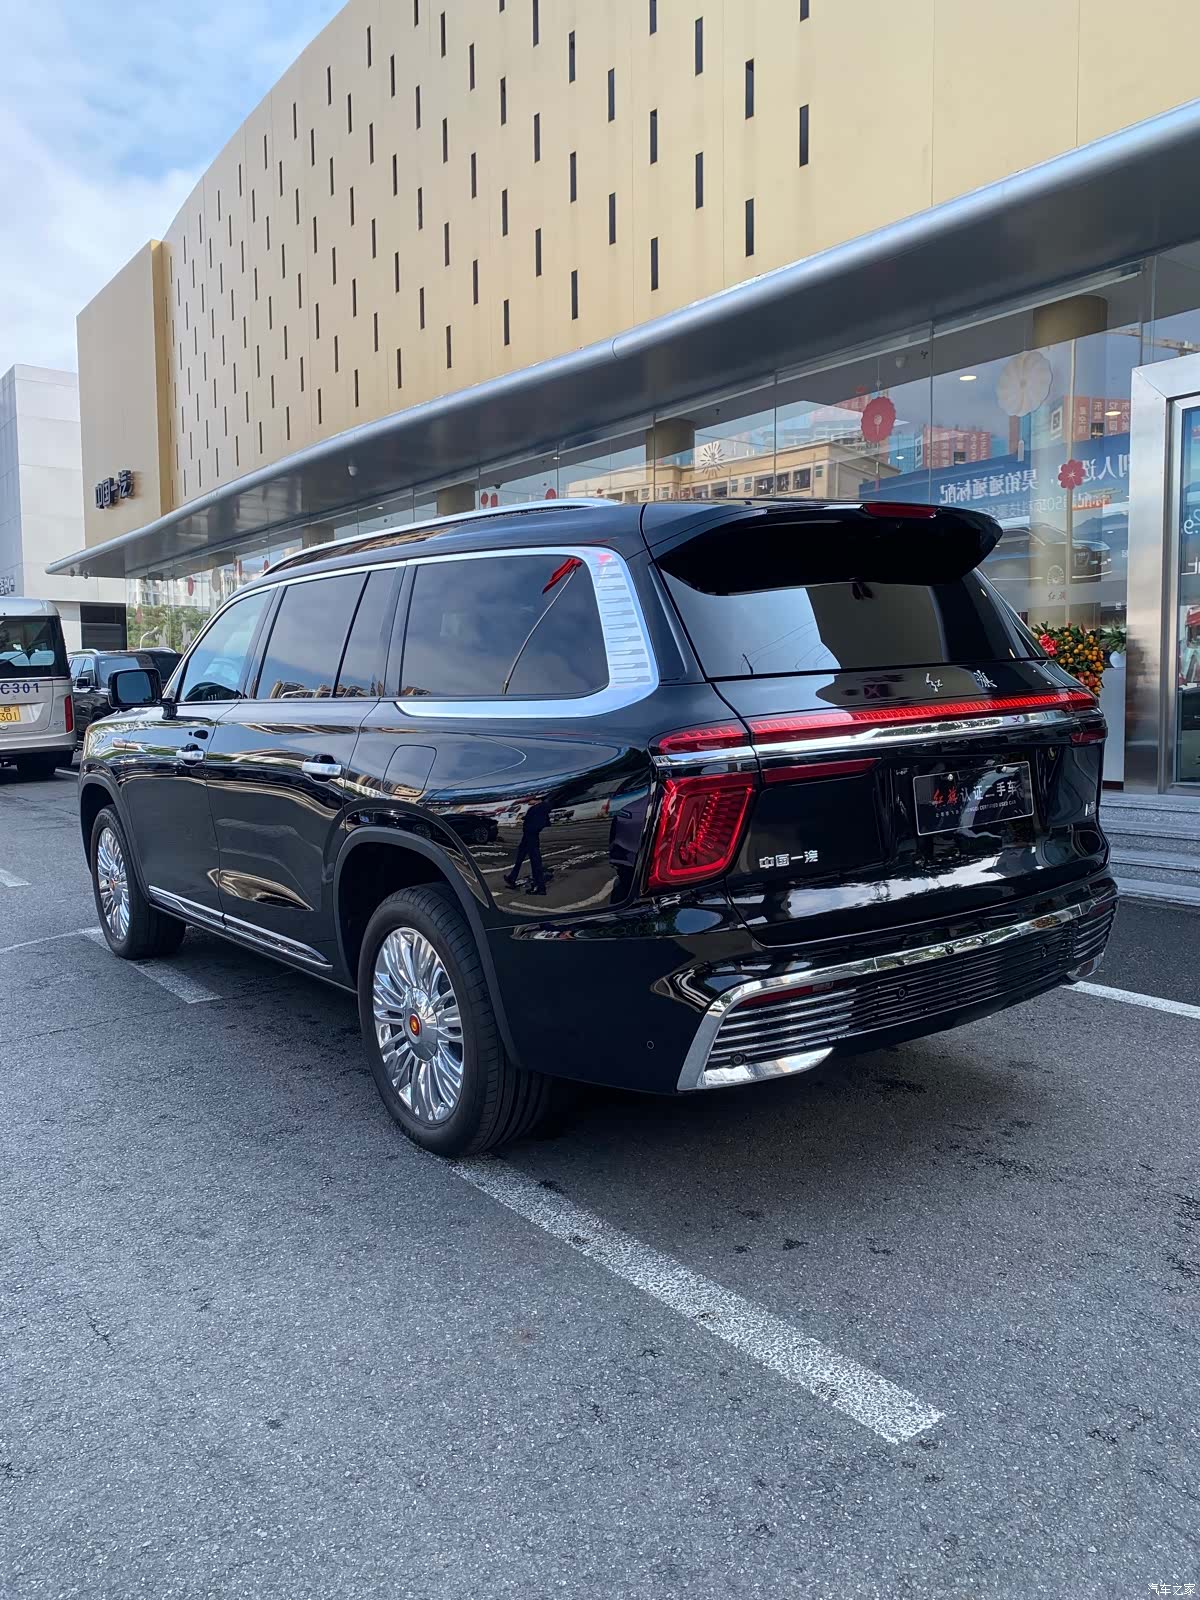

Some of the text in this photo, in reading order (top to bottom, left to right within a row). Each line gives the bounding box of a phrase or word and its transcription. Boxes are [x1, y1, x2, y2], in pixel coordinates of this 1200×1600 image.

[95, 470, 134, 509] 中国一汽
[759, 850, 818, 869] 中国一汽
